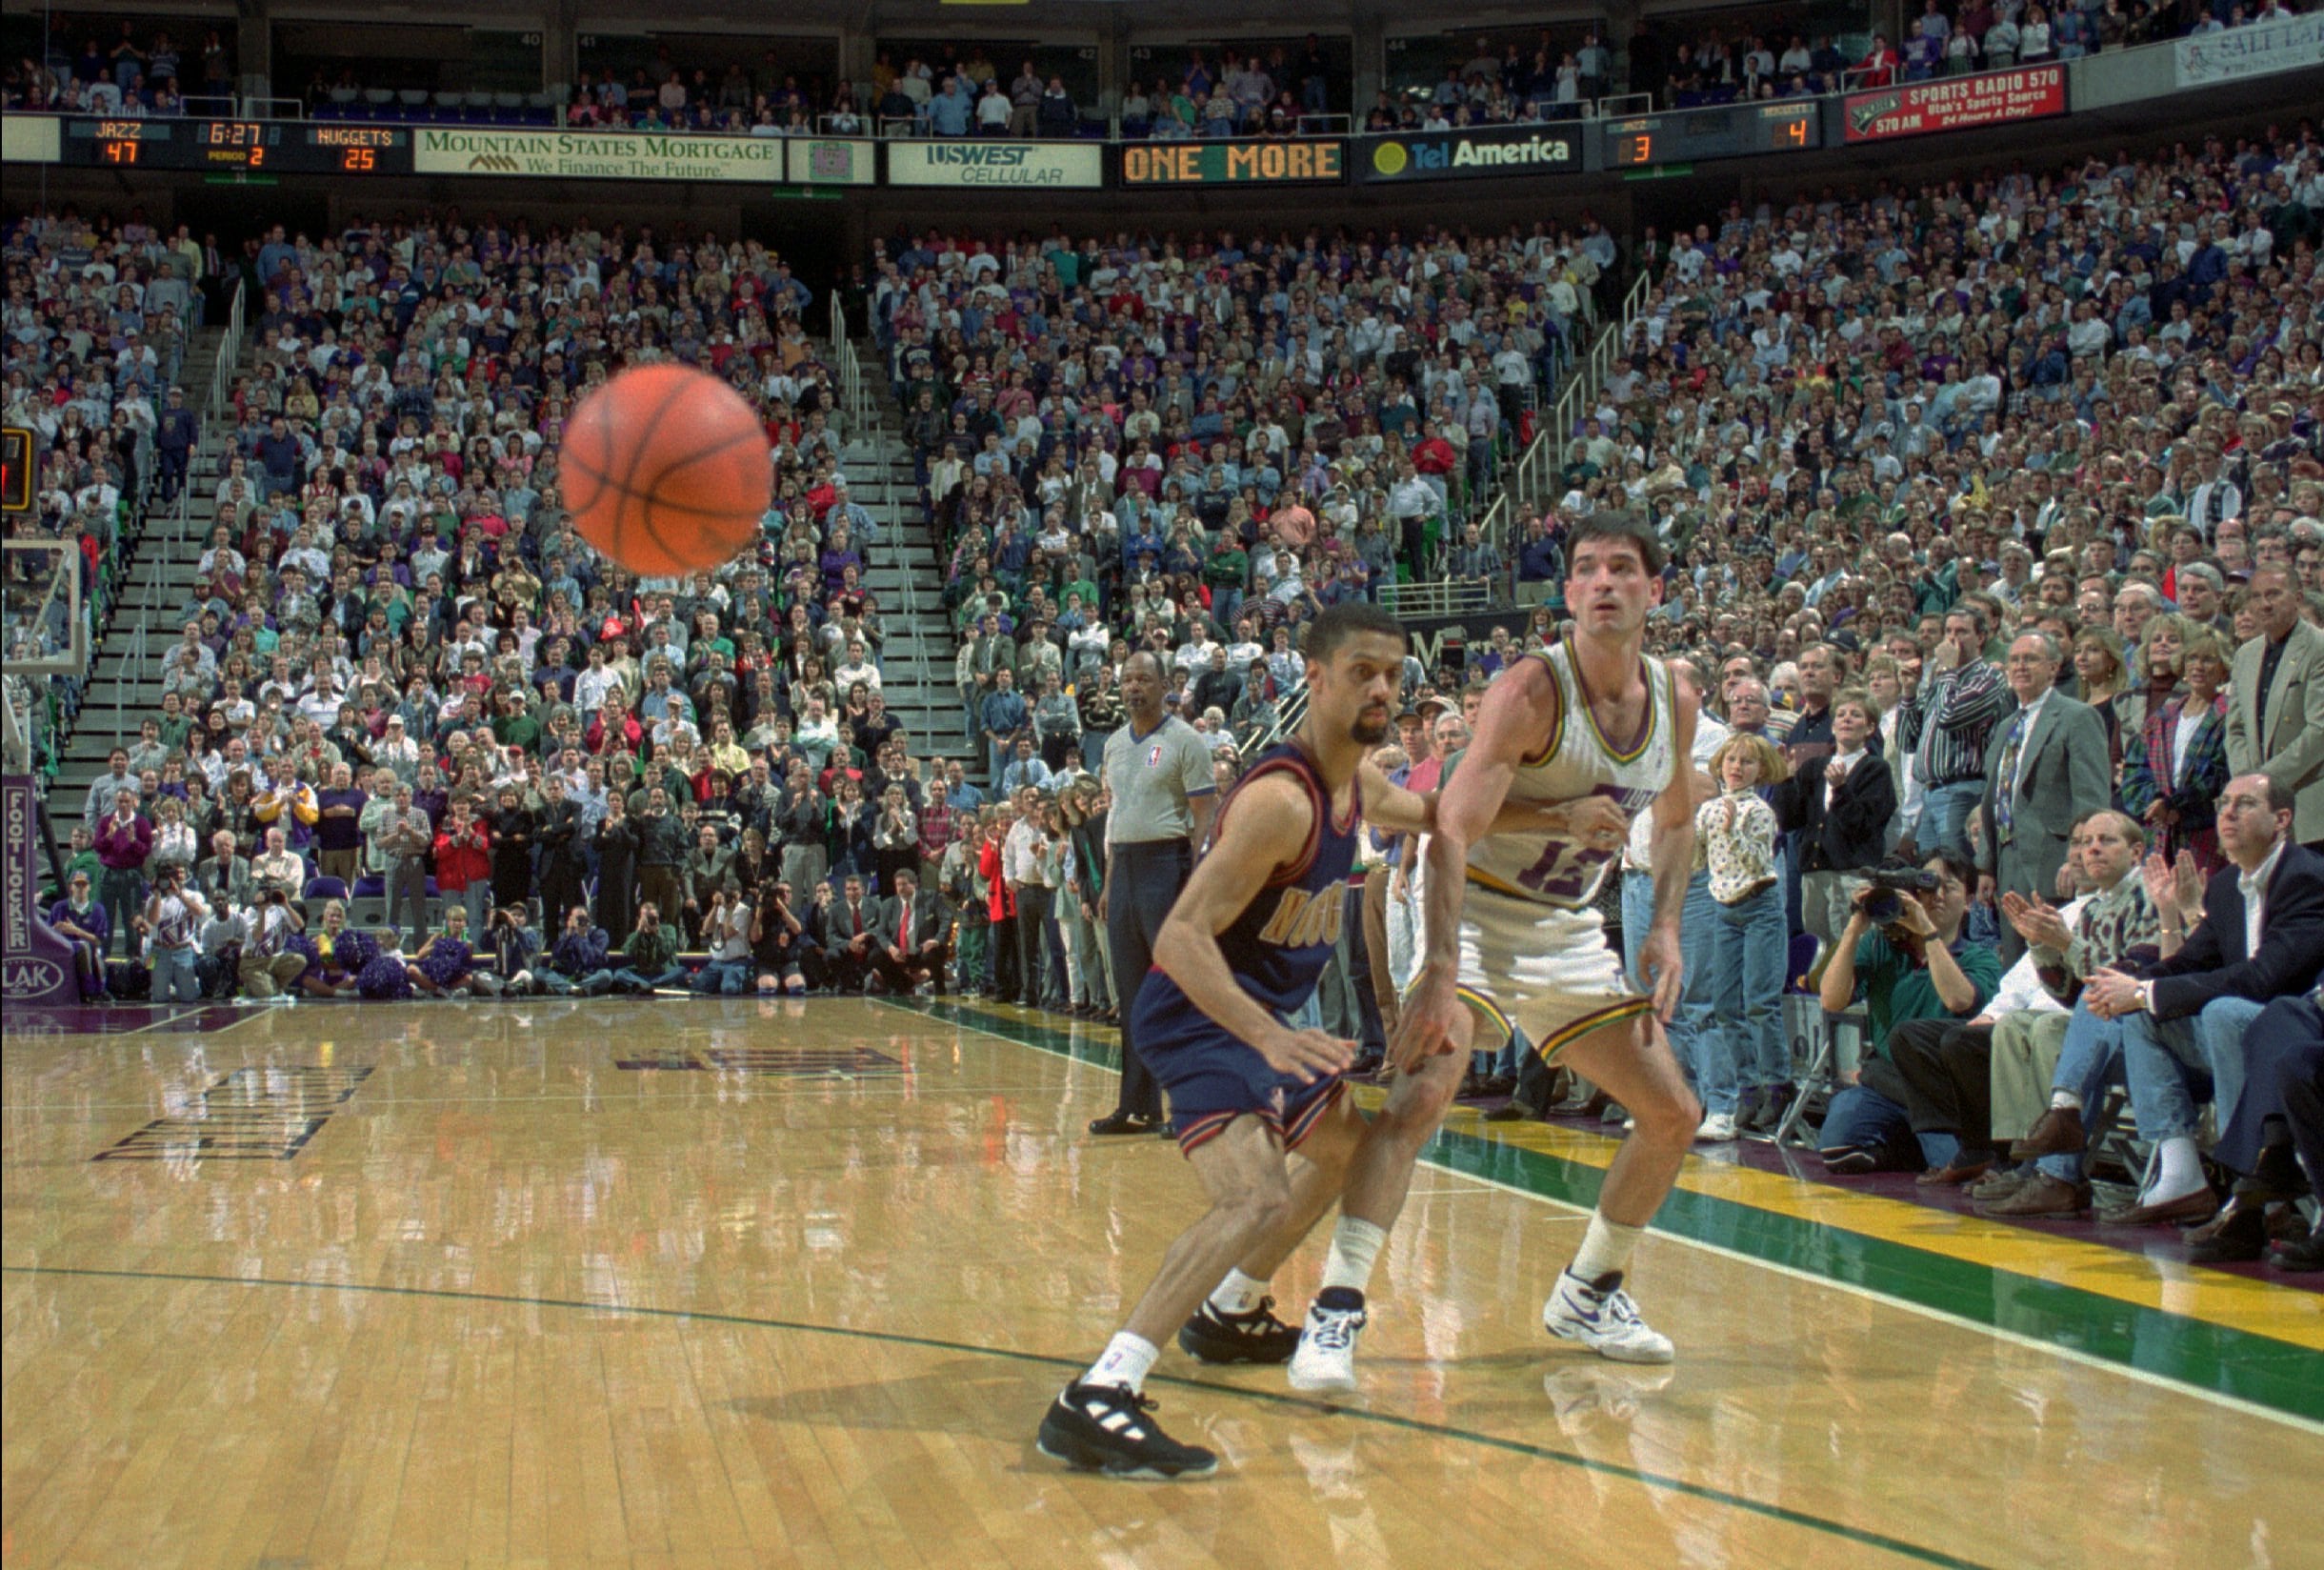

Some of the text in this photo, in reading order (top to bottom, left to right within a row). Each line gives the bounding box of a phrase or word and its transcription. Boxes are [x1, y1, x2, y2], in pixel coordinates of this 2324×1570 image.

[522, 32, 540, 46] 40
[1910, 70, 2058, 105] SPORTS RADIO 570
[1928, 101, 1962, 114] Utah's
[1967, 95, 2003, 110] Sports
[1876, 114, 1922, 133] 570 AM
[1959, 111, 1992, 123] Hours
[1993, 109, 2003, 118] A
[95, 121, 142, 139] JAZZ
[210, 123, 261, 144] 6:27
[317, 129, 392, 146] NUGGETS
[1791, 119, 1807, 146] 4
[108, 141, 137, 163] 47
[250, 147, 263, 166] 2
[426, 131, 774, 161] MOUNTAIN STATES MORTGAGE
[1412, 135, 1569, 169] Tel America
[1633, 136, 1650, 162] 3
[345, 148, 375, 169] 25
[526, 157, 552, 173] We
[558, 158, 624, 175] Finance
[628, 160, 660, 175] The
[1124, 143, 1339, 181] ONE MORE
[961, 167, 1063, 184] CELLULAR
[9, 792, 24, 853] FOOT
[9, 855, 27, 947] LOCKER
